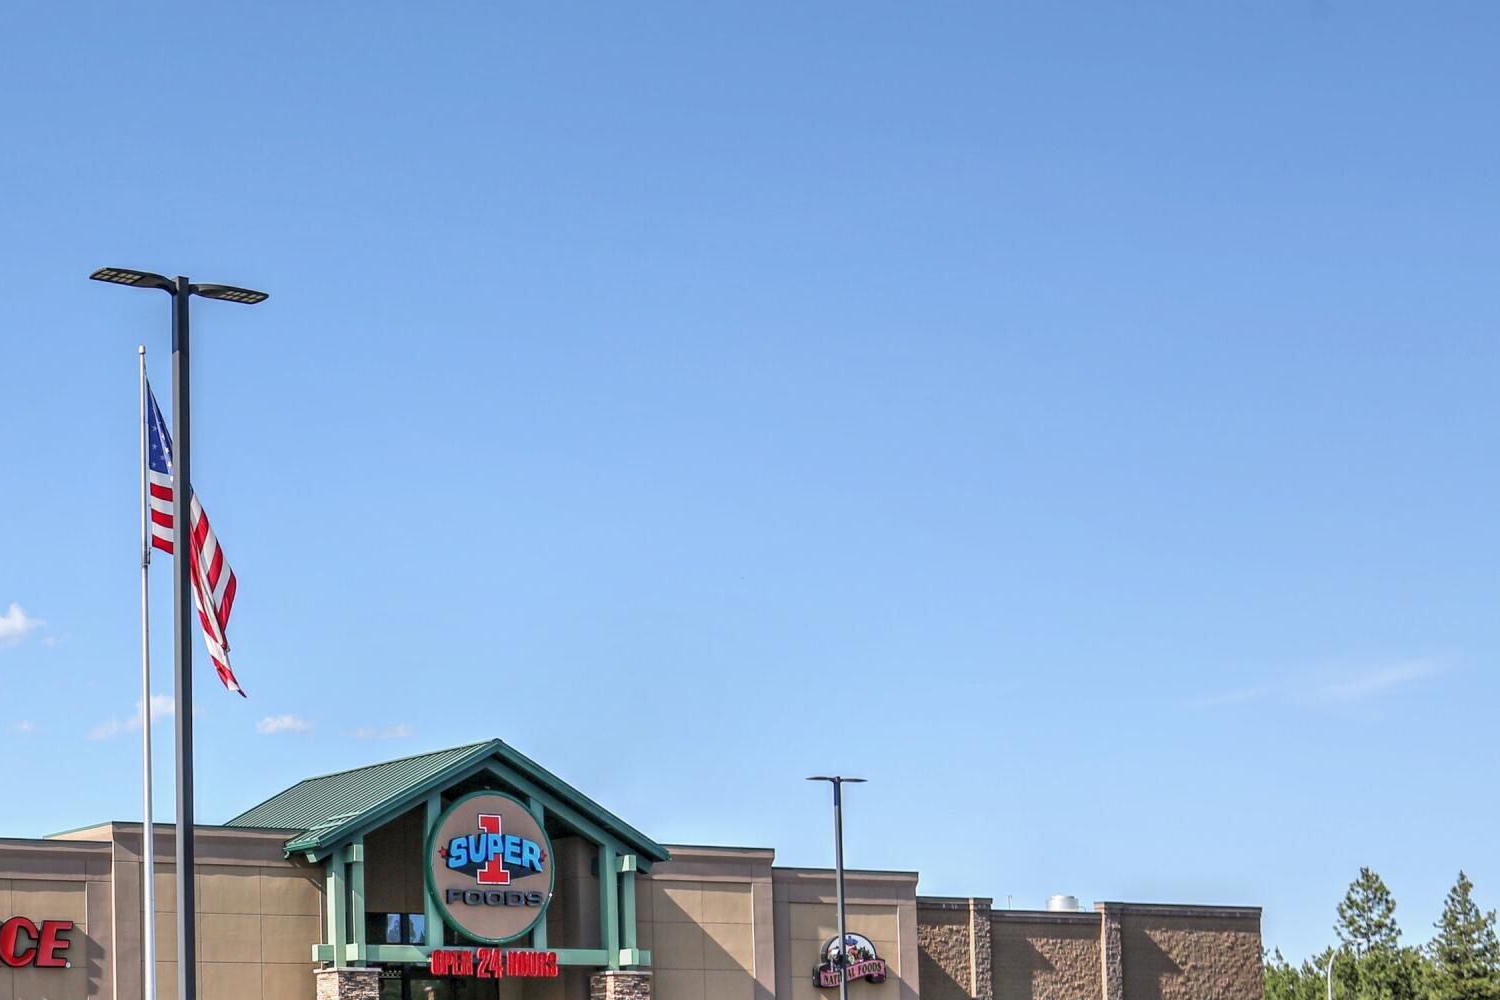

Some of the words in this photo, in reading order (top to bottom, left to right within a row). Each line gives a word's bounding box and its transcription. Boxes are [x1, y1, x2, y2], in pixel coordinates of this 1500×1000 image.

[448, 833, 543, 873] SUPER
[446, 889, 545, 908] FOODS
[430, 949, 474, 976] OPEN
[476, 947, 503, 979] 24
[506, 950, 559, 977] HOURS
[858, 961, 882, 976] FOODS
